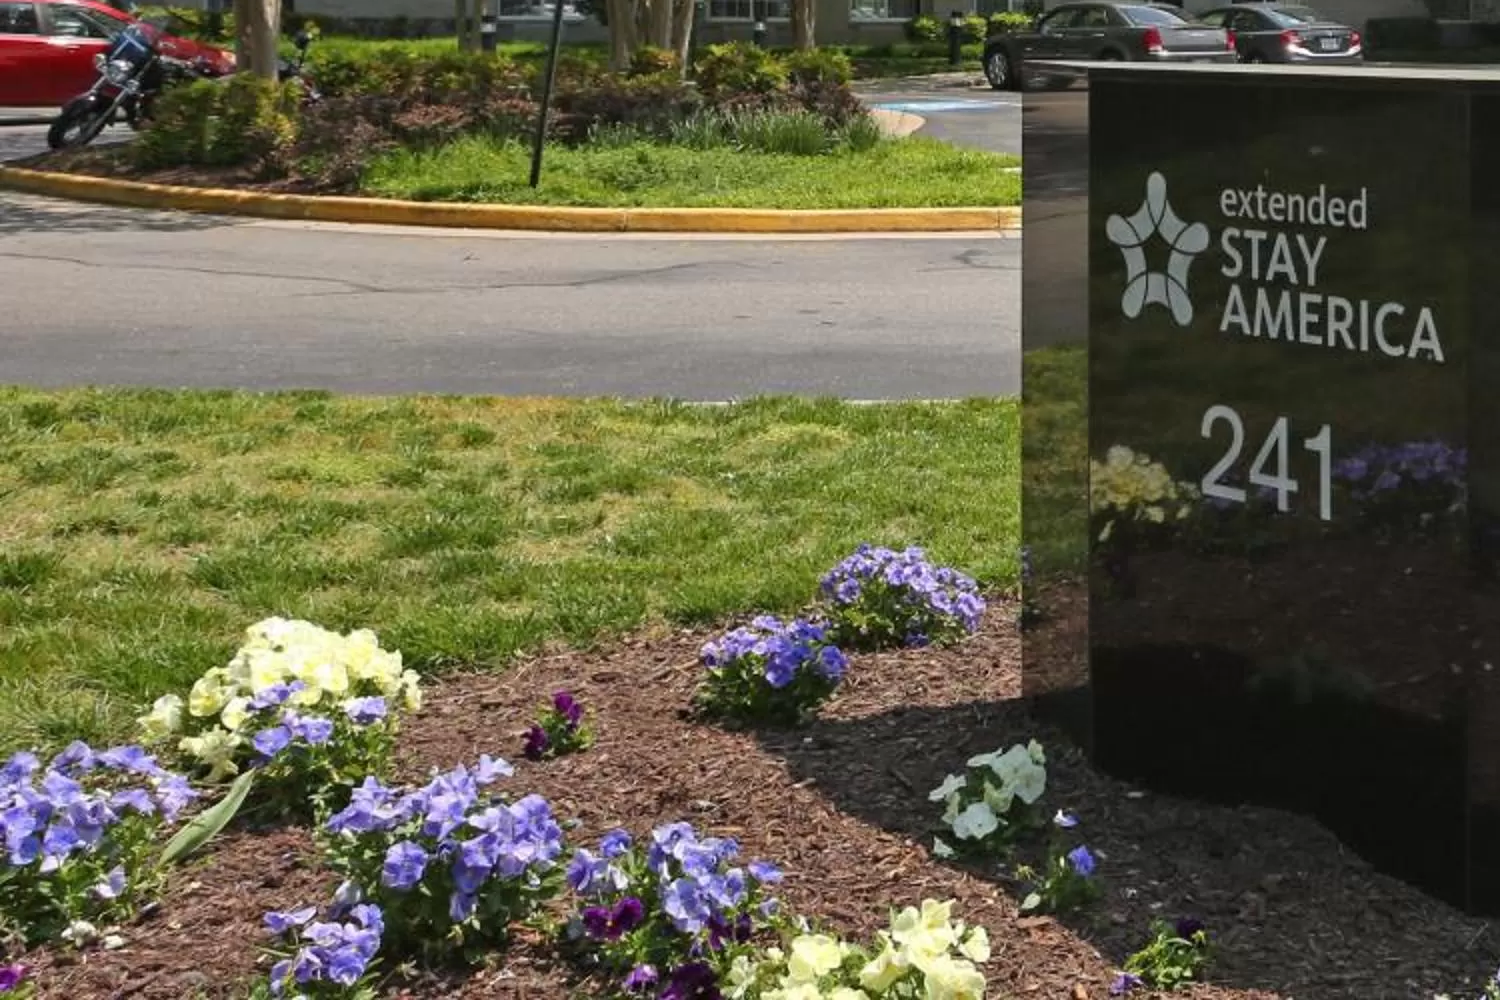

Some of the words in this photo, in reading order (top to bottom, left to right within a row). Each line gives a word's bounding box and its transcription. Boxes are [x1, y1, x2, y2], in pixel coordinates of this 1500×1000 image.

[1220, 184, 1367, 229] extended
[1220, 227, 1327, 287] STAY
[1220, 284, 1444, 363] AMERICA
[1201, 404, 1332, 521] 241
